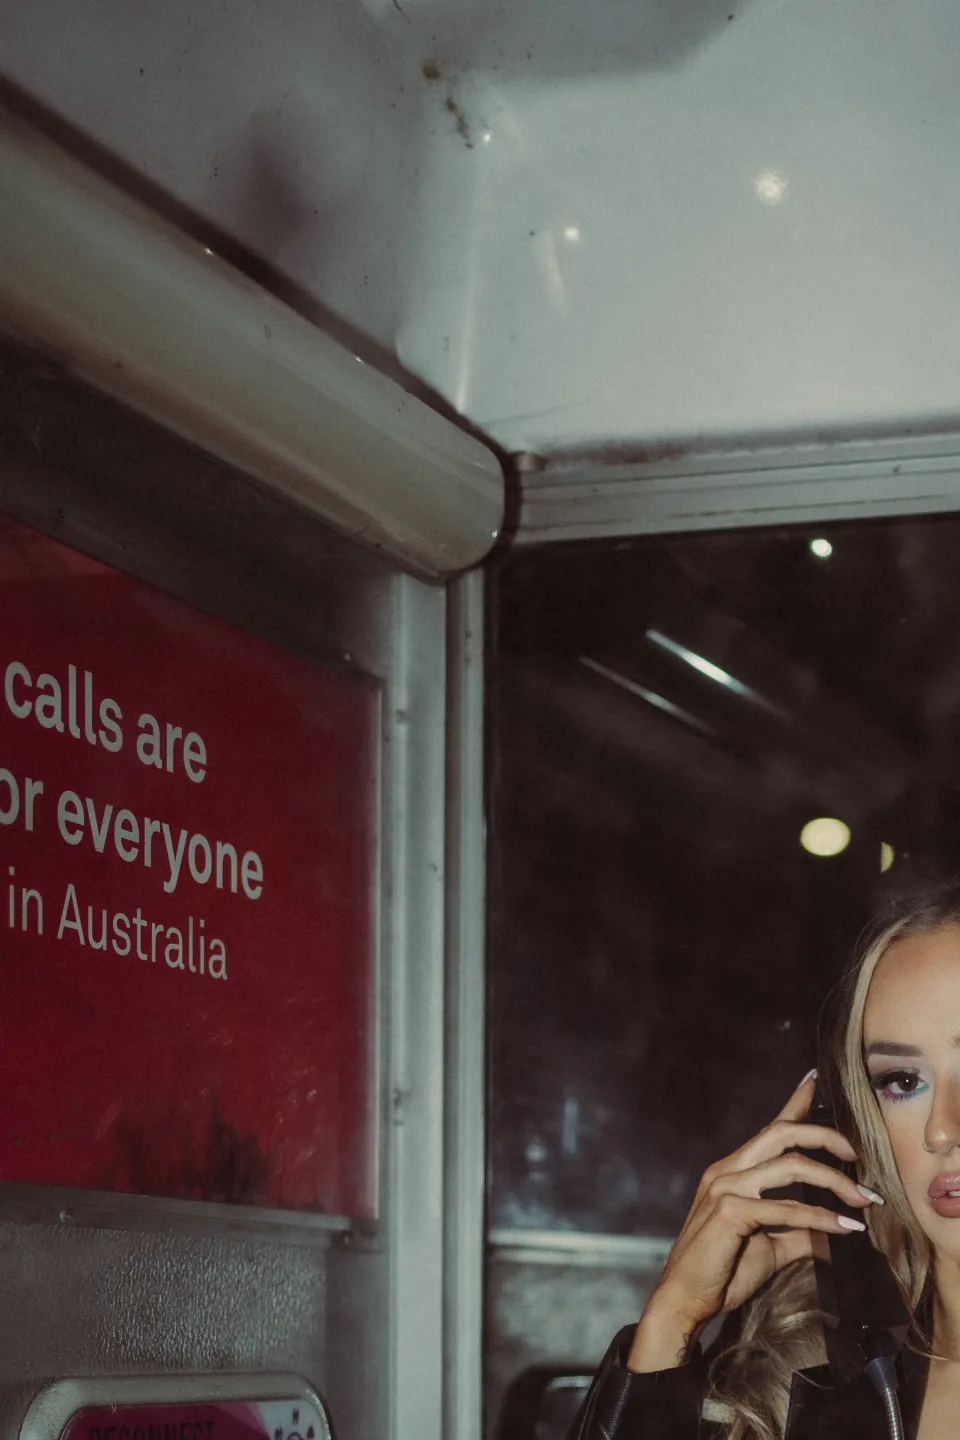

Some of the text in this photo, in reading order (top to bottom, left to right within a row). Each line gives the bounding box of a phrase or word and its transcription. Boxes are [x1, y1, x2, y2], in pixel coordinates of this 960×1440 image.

[4, 661, 208, 783] calls are
[57, 789, 264, 900] everyone
[8, 866, 228, 980] in Australia
